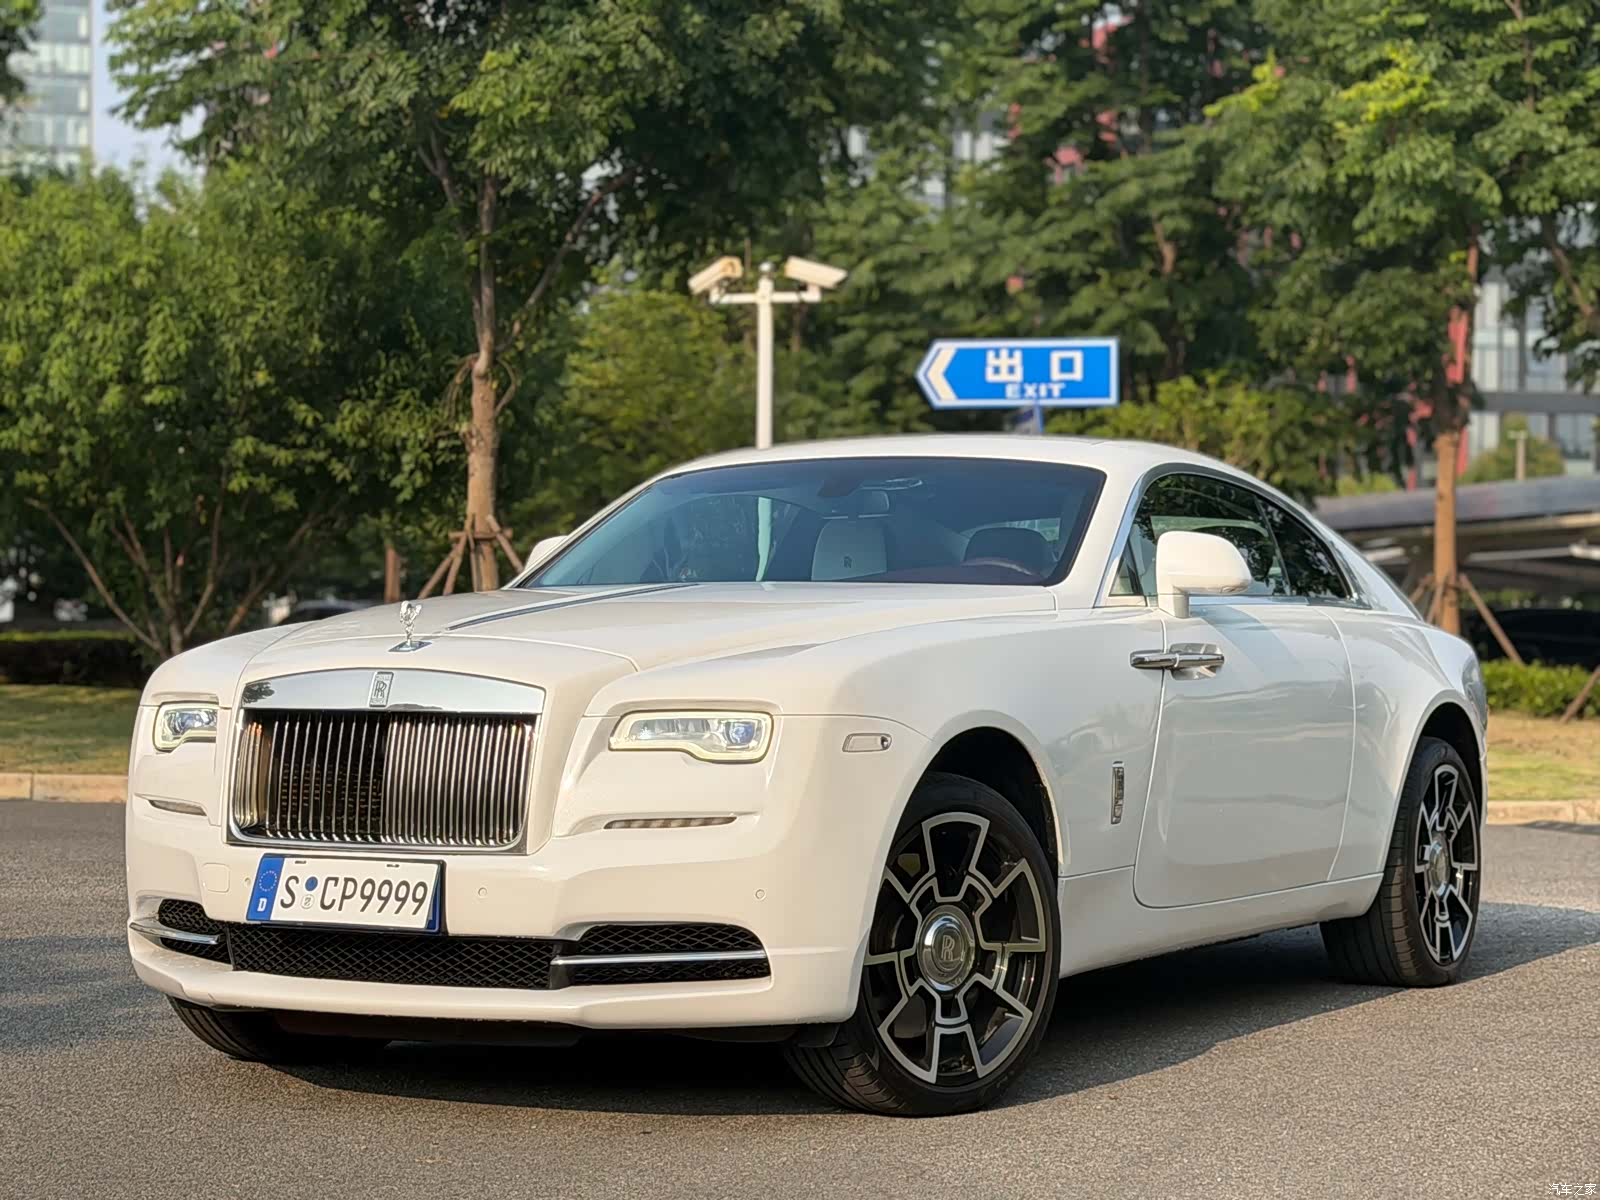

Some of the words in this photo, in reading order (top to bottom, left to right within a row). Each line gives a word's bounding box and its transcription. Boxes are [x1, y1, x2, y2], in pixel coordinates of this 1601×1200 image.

[985, 349, 1083, 382] 出口
[1005, 383, 1066, 398] EXIT
[257, 898, 267, 912] D
[280, 875, 299, 908] S
[320, 876, 428, 915] CP9999
